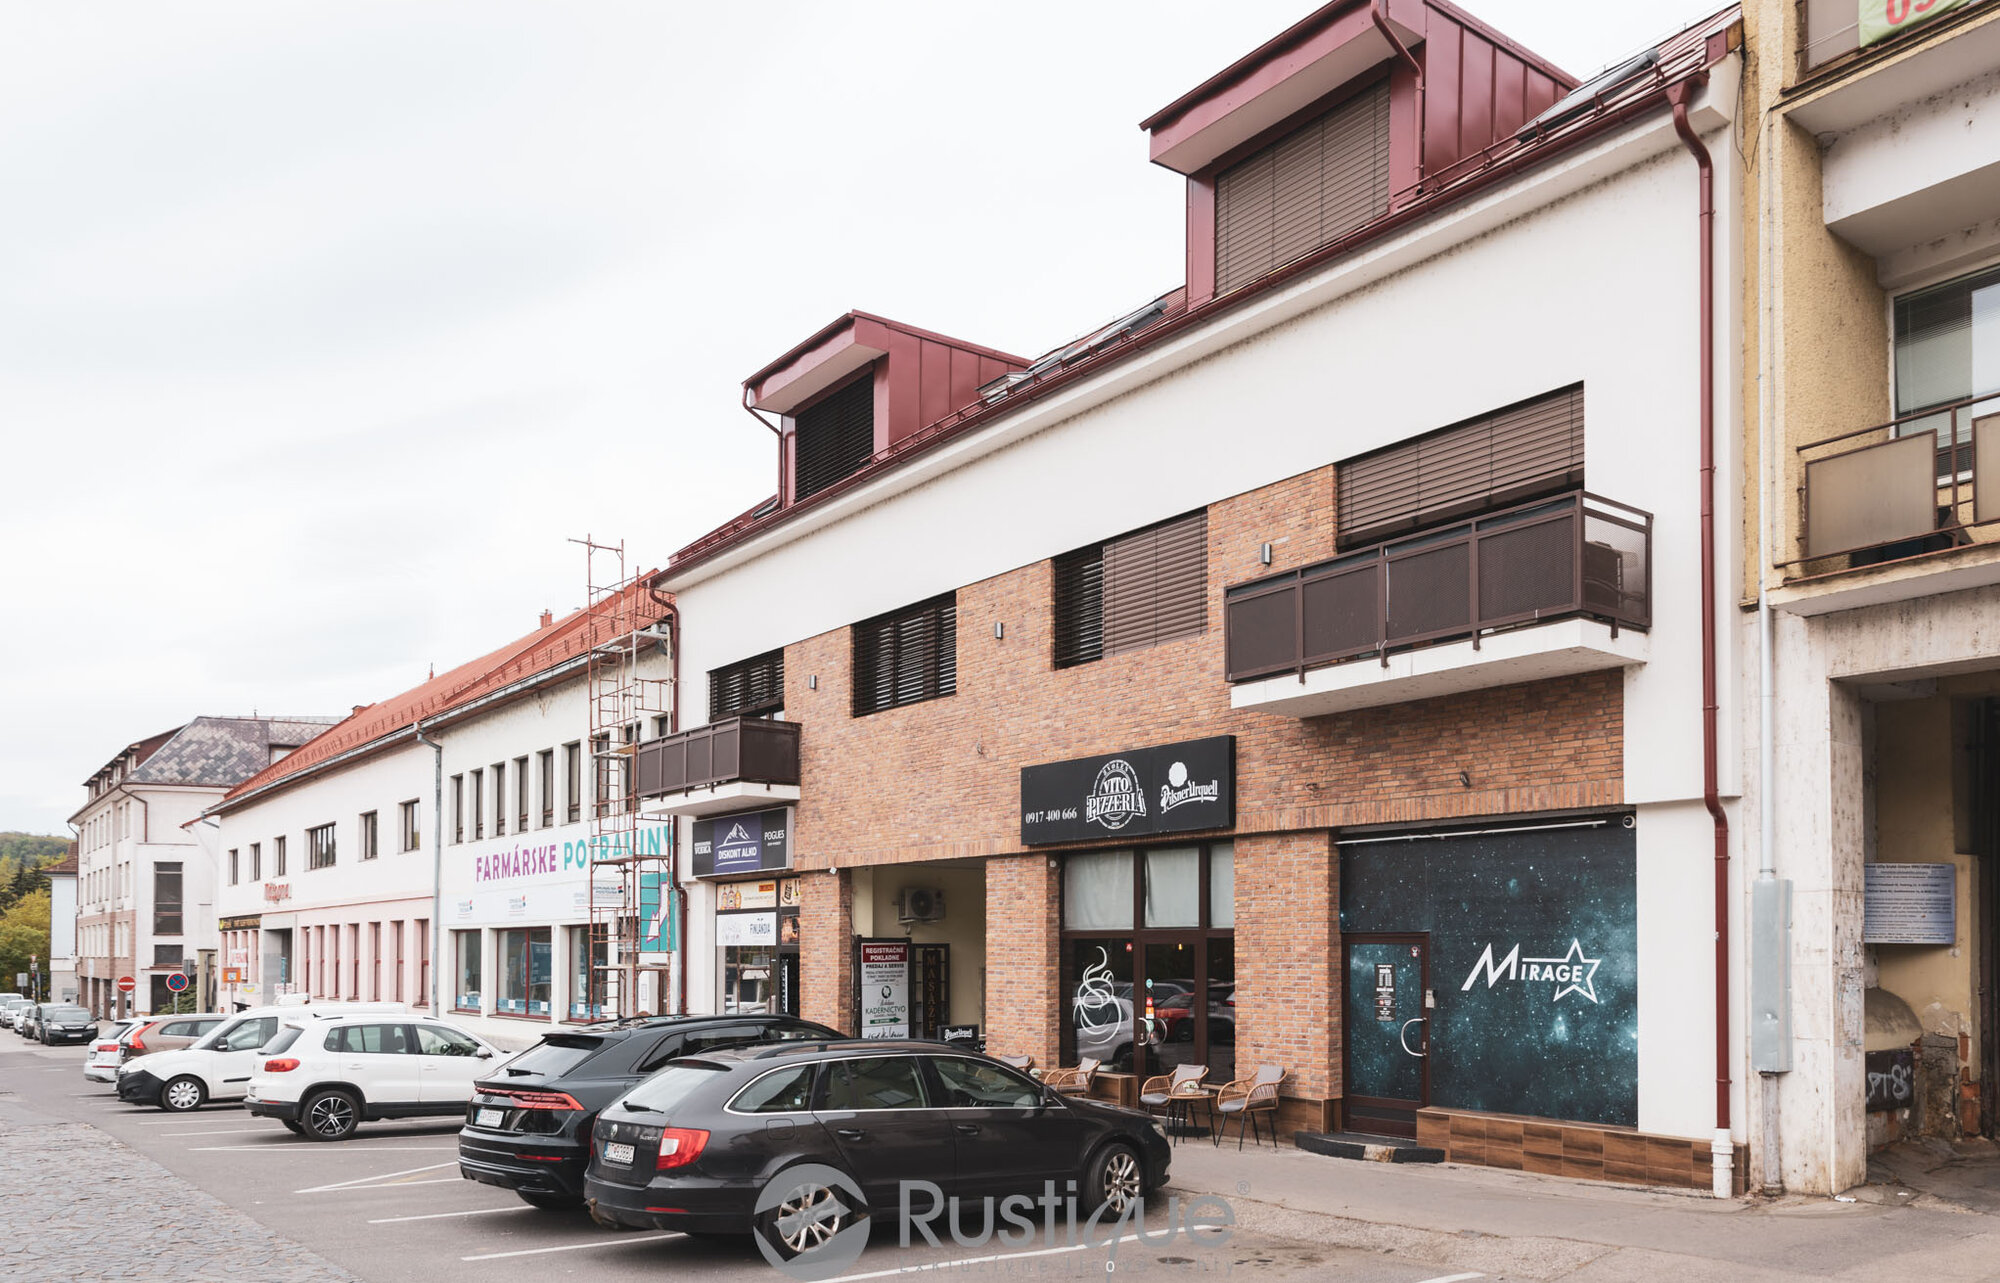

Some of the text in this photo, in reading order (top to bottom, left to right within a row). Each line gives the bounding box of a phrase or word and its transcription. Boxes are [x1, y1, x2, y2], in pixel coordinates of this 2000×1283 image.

[1103, 777, 1129, 794] VITO
[1088, 791, 1145, 819] PIZZERIA
[1160, 780, 1218, 814] Pilsner Urquell
[1025, 807, 1078, 824] 0917 400 666
[764, 829, 785, 841] POGUES
[476, 843, 557, 883] FARMÁRSKE
[718, 846, 757, 860] DISKONT ALKO
[1461, 942, 1584, 991] MIRAGE
